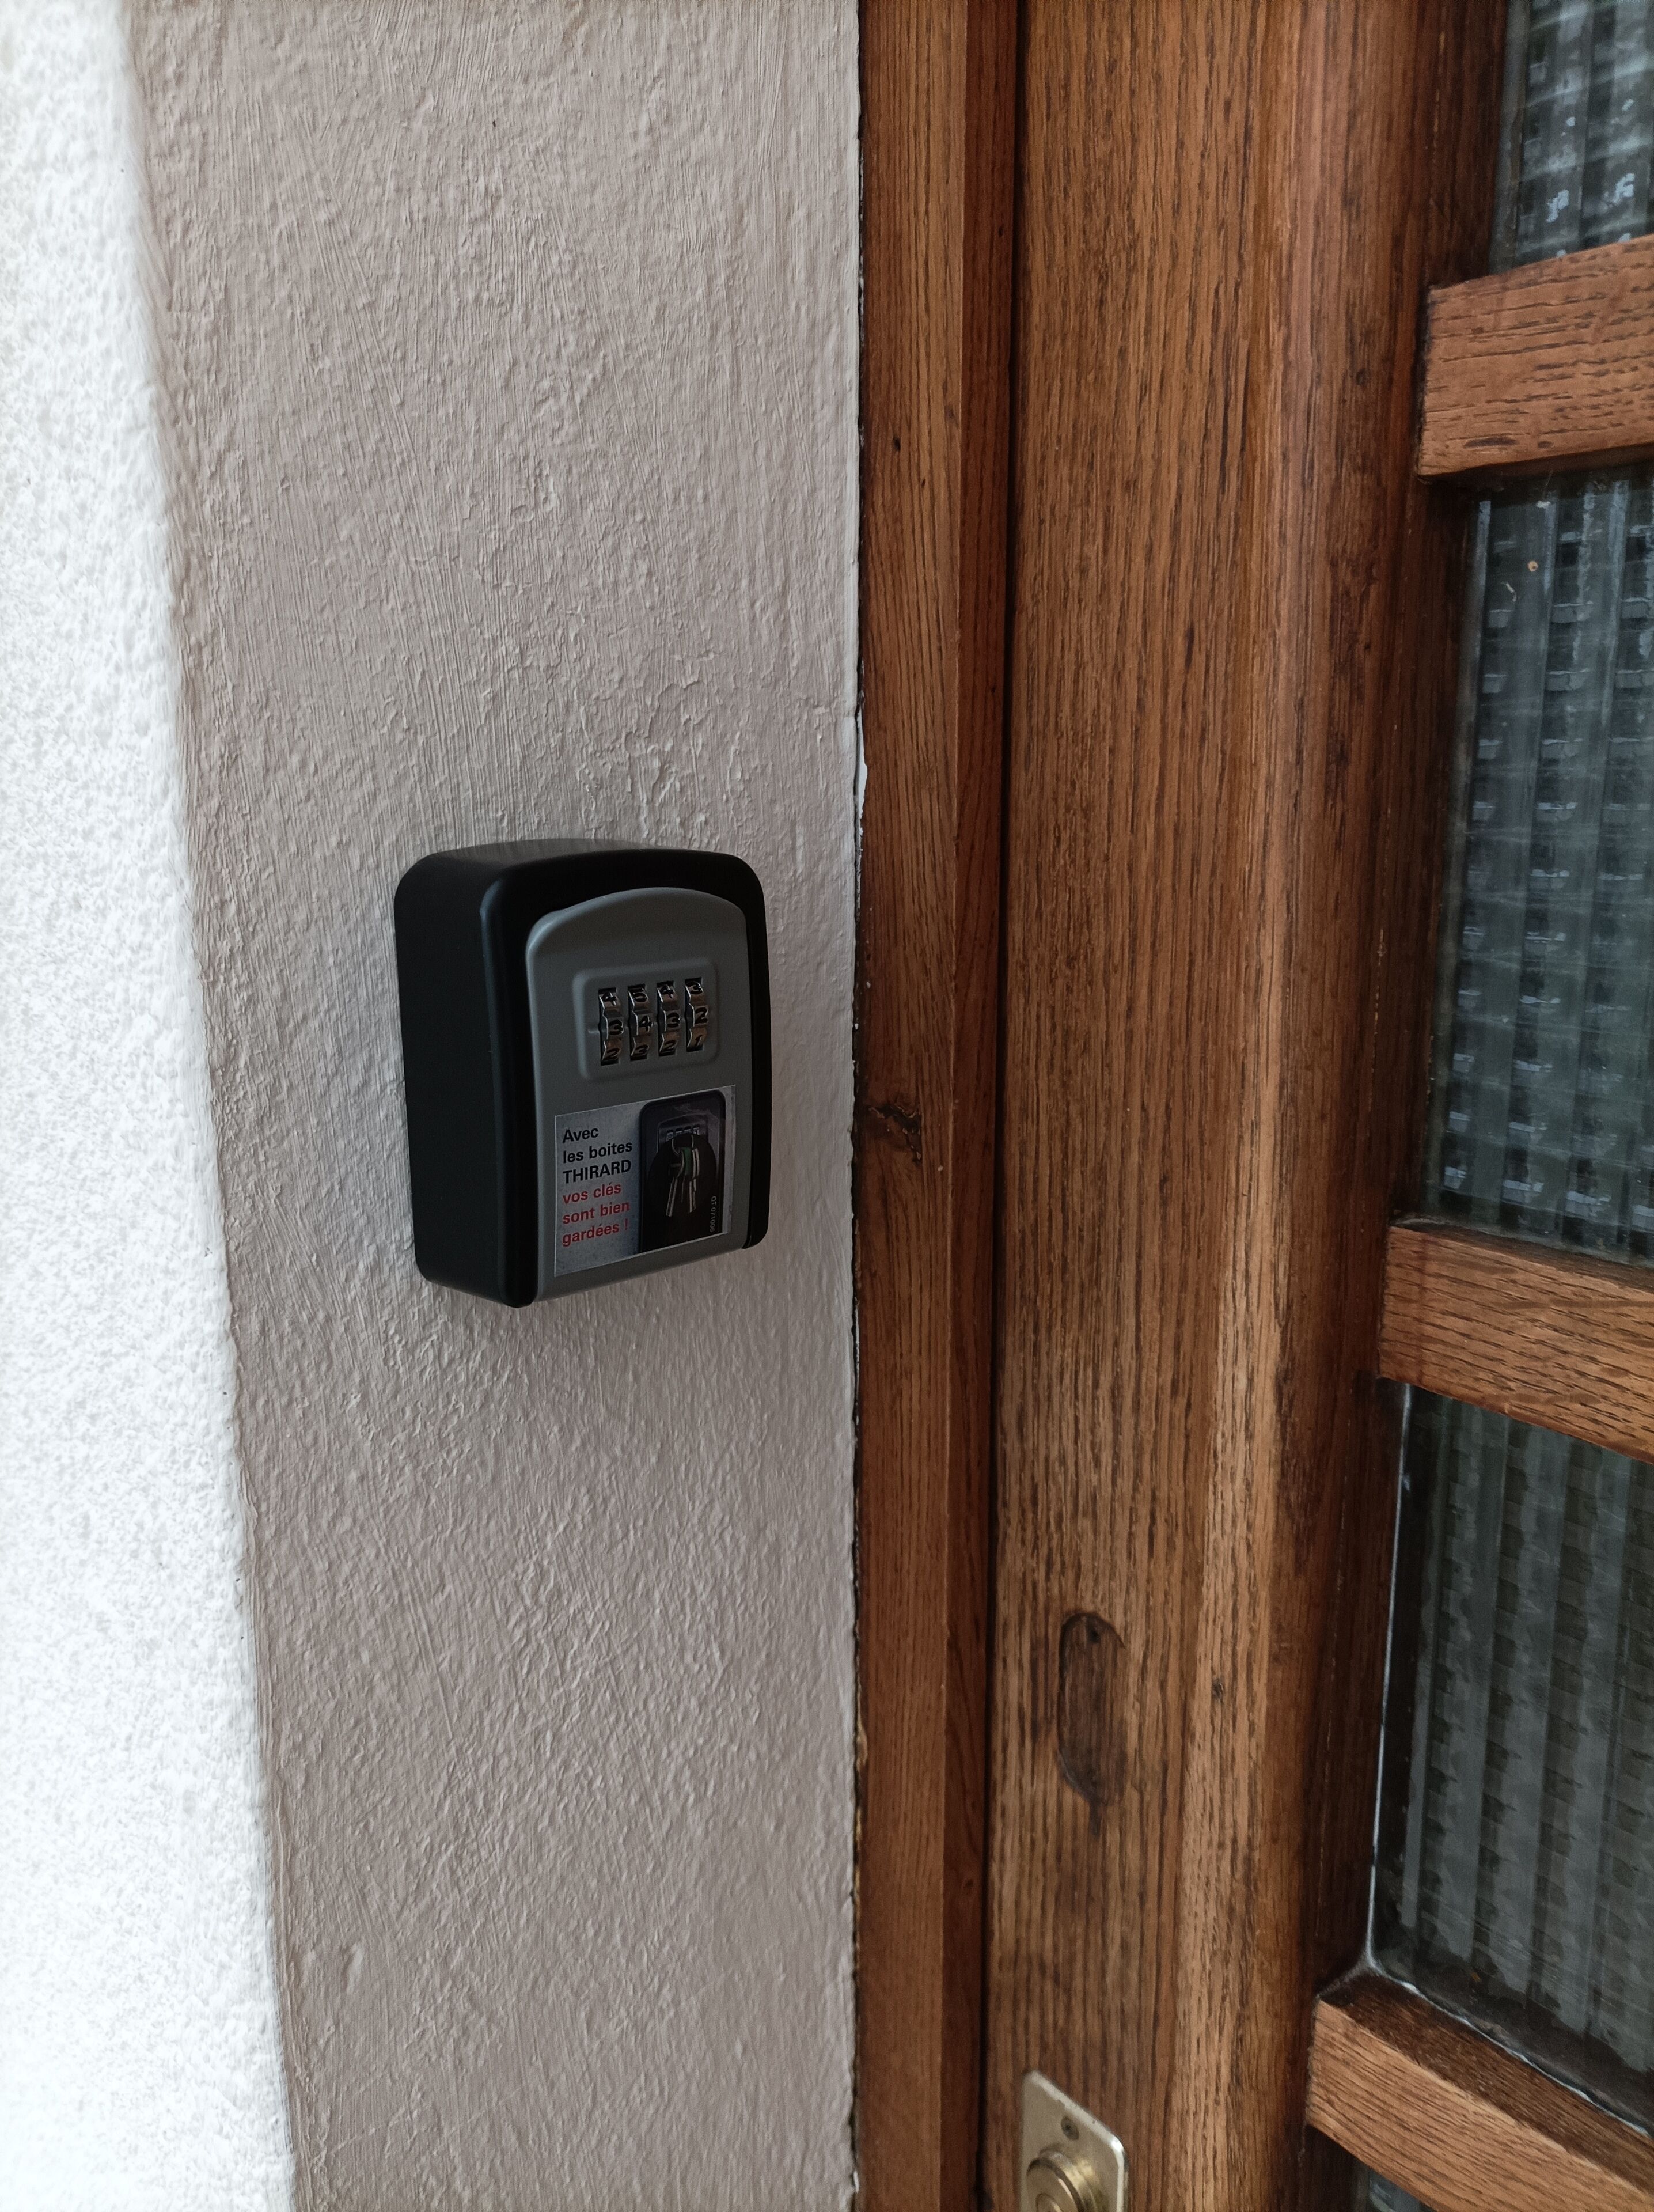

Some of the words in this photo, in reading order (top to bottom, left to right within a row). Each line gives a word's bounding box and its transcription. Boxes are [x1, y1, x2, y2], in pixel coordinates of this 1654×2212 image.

[609, 1019, 624, 1036] 3
[639, 1015, 653, 1032] 4
[667, 1012, 681, 1028] 3
[695, 1007, 708, 1024] 2
[606, 1047, 620, 1060] 2
[635, 1044, 649, 1056] 3
[665, 1039, 677, 1052] 2
[562, 1127, 599, 1143] Avec
[563, 1150, 584, 1164] les
[589, 1141, 633, 1159] boites
[562, 1158, 632, 1184] THIRARD
[563, 1190, 588, 1204] vos
[593, 1181, 621, 1199] clés
[711, 1195, 717, 1206] QT
[563, 1207, 595, 1224] sont
[600, 1200, 630, 1216] bien
[562, 1222, 619, 1247] gardées
